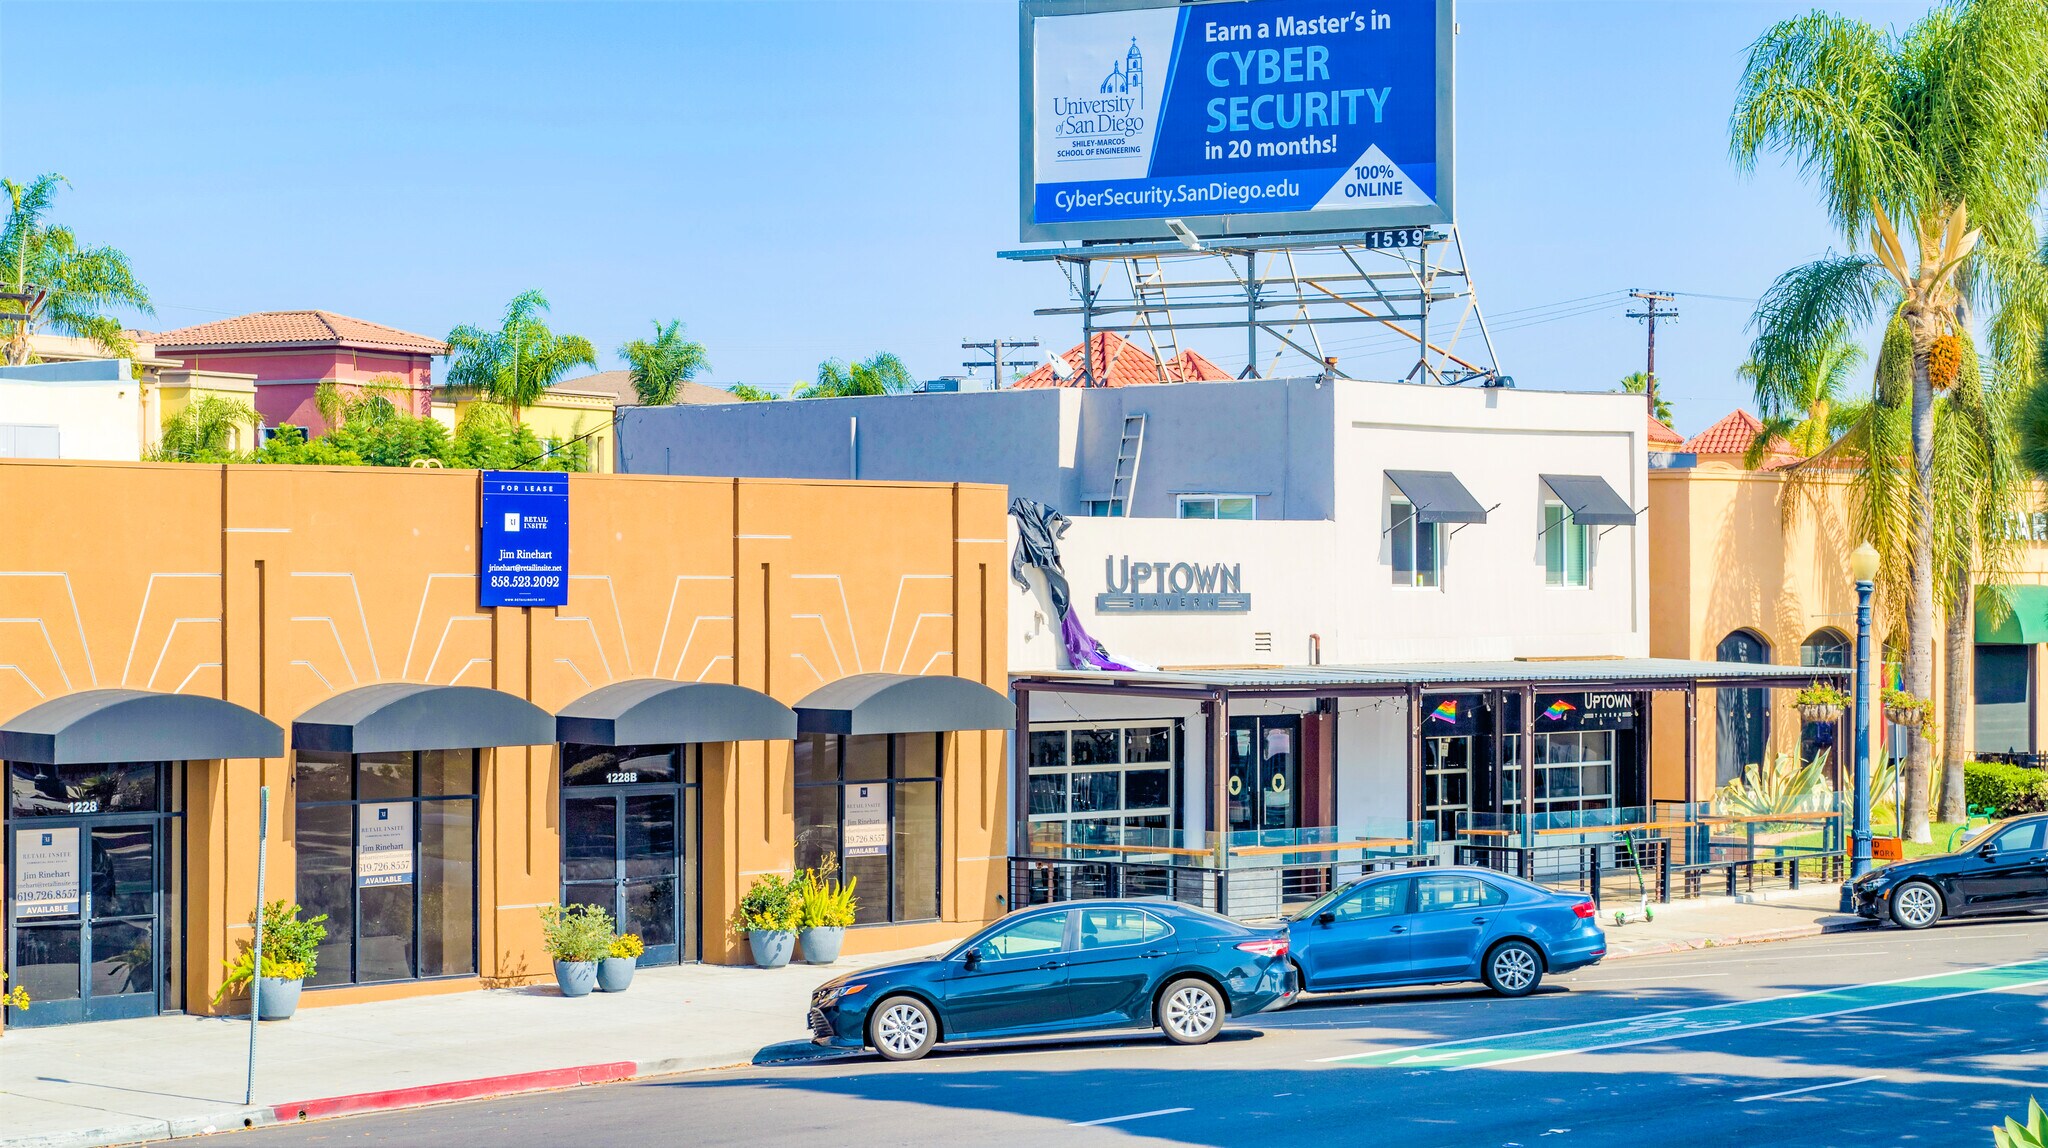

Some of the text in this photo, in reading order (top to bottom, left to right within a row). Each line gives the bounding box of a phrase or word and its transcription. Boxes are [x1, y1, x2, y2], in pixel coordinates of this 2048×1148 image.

[1205, 10, 1391, 43] Earn a Master's in
[1206, 45, 1330, 87] CYBER
[1053, 95, 1136, 118] University
[1206, 86, 1392, 133] SECURITY
[1055, 114, 1144, 137] of San Diego
[1072, 138, 1126, 148] SHILEY-MARCOS
[1205, 134, 1337, 160] in 20 months!
[1057, 146, 1141, 157] SCHOOL OF ENGINEERING
[1354, 164, 1394, 180] 100%
[1055, 178, 1300, 213] CyberSecurity.SanDiego.edu
[1344, 181, 1403, 198] ONLINE
[1371, 229, 1423, 248] 1539
[501, 484, 519, 492] FOR
[498, 549, 553, 561] Jim Rinehart
[1106, 555, 1241, 593] UPTOWN
[491, 575, 560, 588] 858.523.2092
[1139, 597, 1214, 607] TAVERN
[1584, 691, 1632, 709] UPTOWN
[606, 772, 638, 783] 1228B
[67, 801, 98, 814] 1228
[361, 843, 404, 854] Jim Rinehart
[848, 847, 879, 855] AVAILABLE
[22, 870, 70, 881] Jim Rinehart
[365, 875, 402, 885] AVAILABLE
[17, 889, 77, 902] 619.726.8557
[26, 904, 69, 914] AVAILABLE
